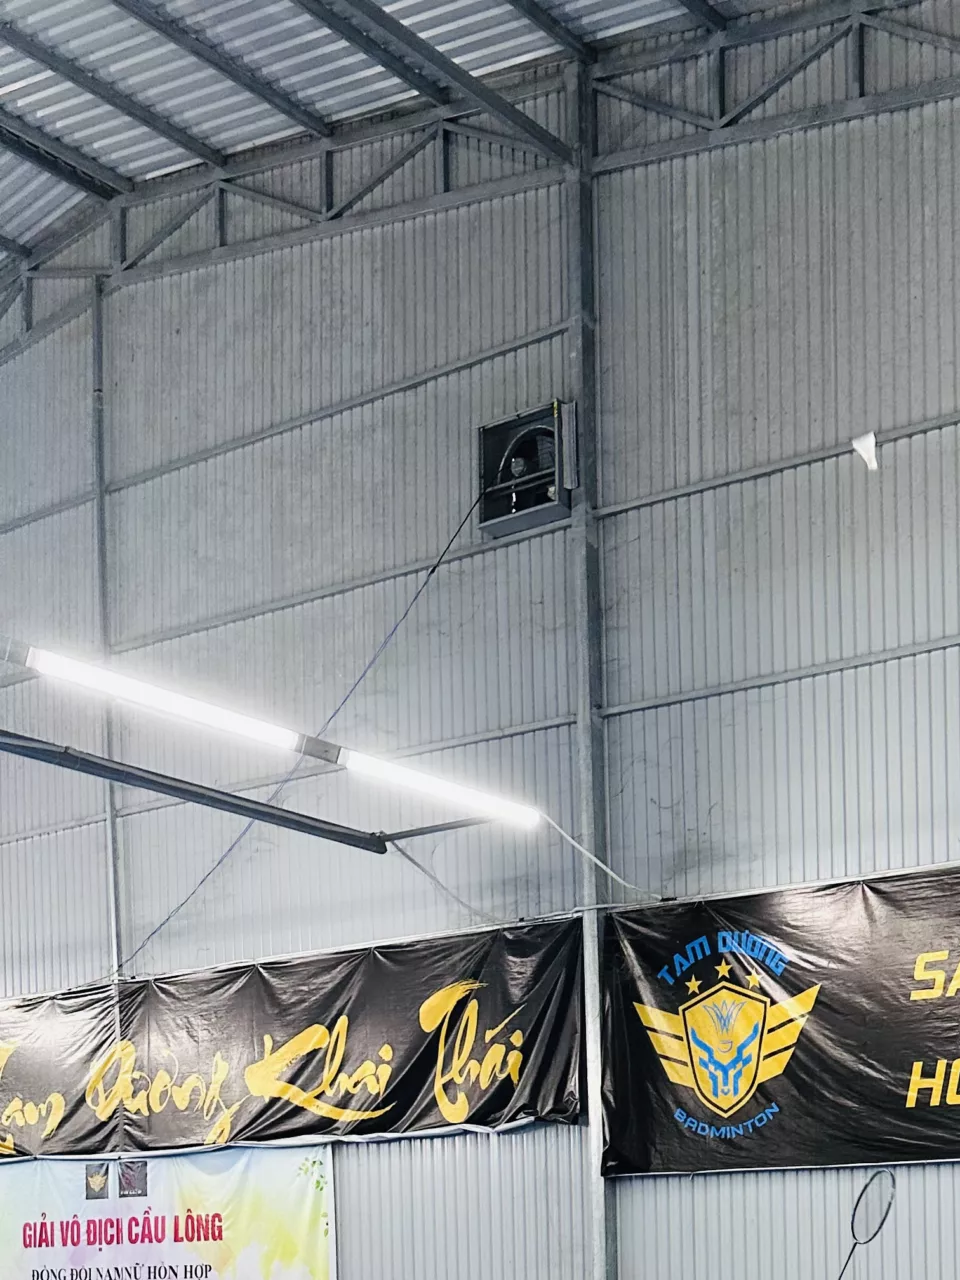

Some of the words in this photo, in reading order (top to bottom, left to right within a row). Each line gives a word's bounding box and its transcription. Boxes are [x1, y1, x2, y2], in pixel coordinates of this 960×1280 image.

[657, 934, 712, 986] TAM
[245, 1014, 397, 1120] Khai
[419, 979, 525, 1123] Thái
[674, 1102, 780, 1139] BADMINTON
[22, 1213, 55, 1249] GIẢI
[60, 1214, 81, 1247] VÔ
[127, 1206, 166, 1244] CẦU
[173, 1208, 224, 1243] LÔNG
